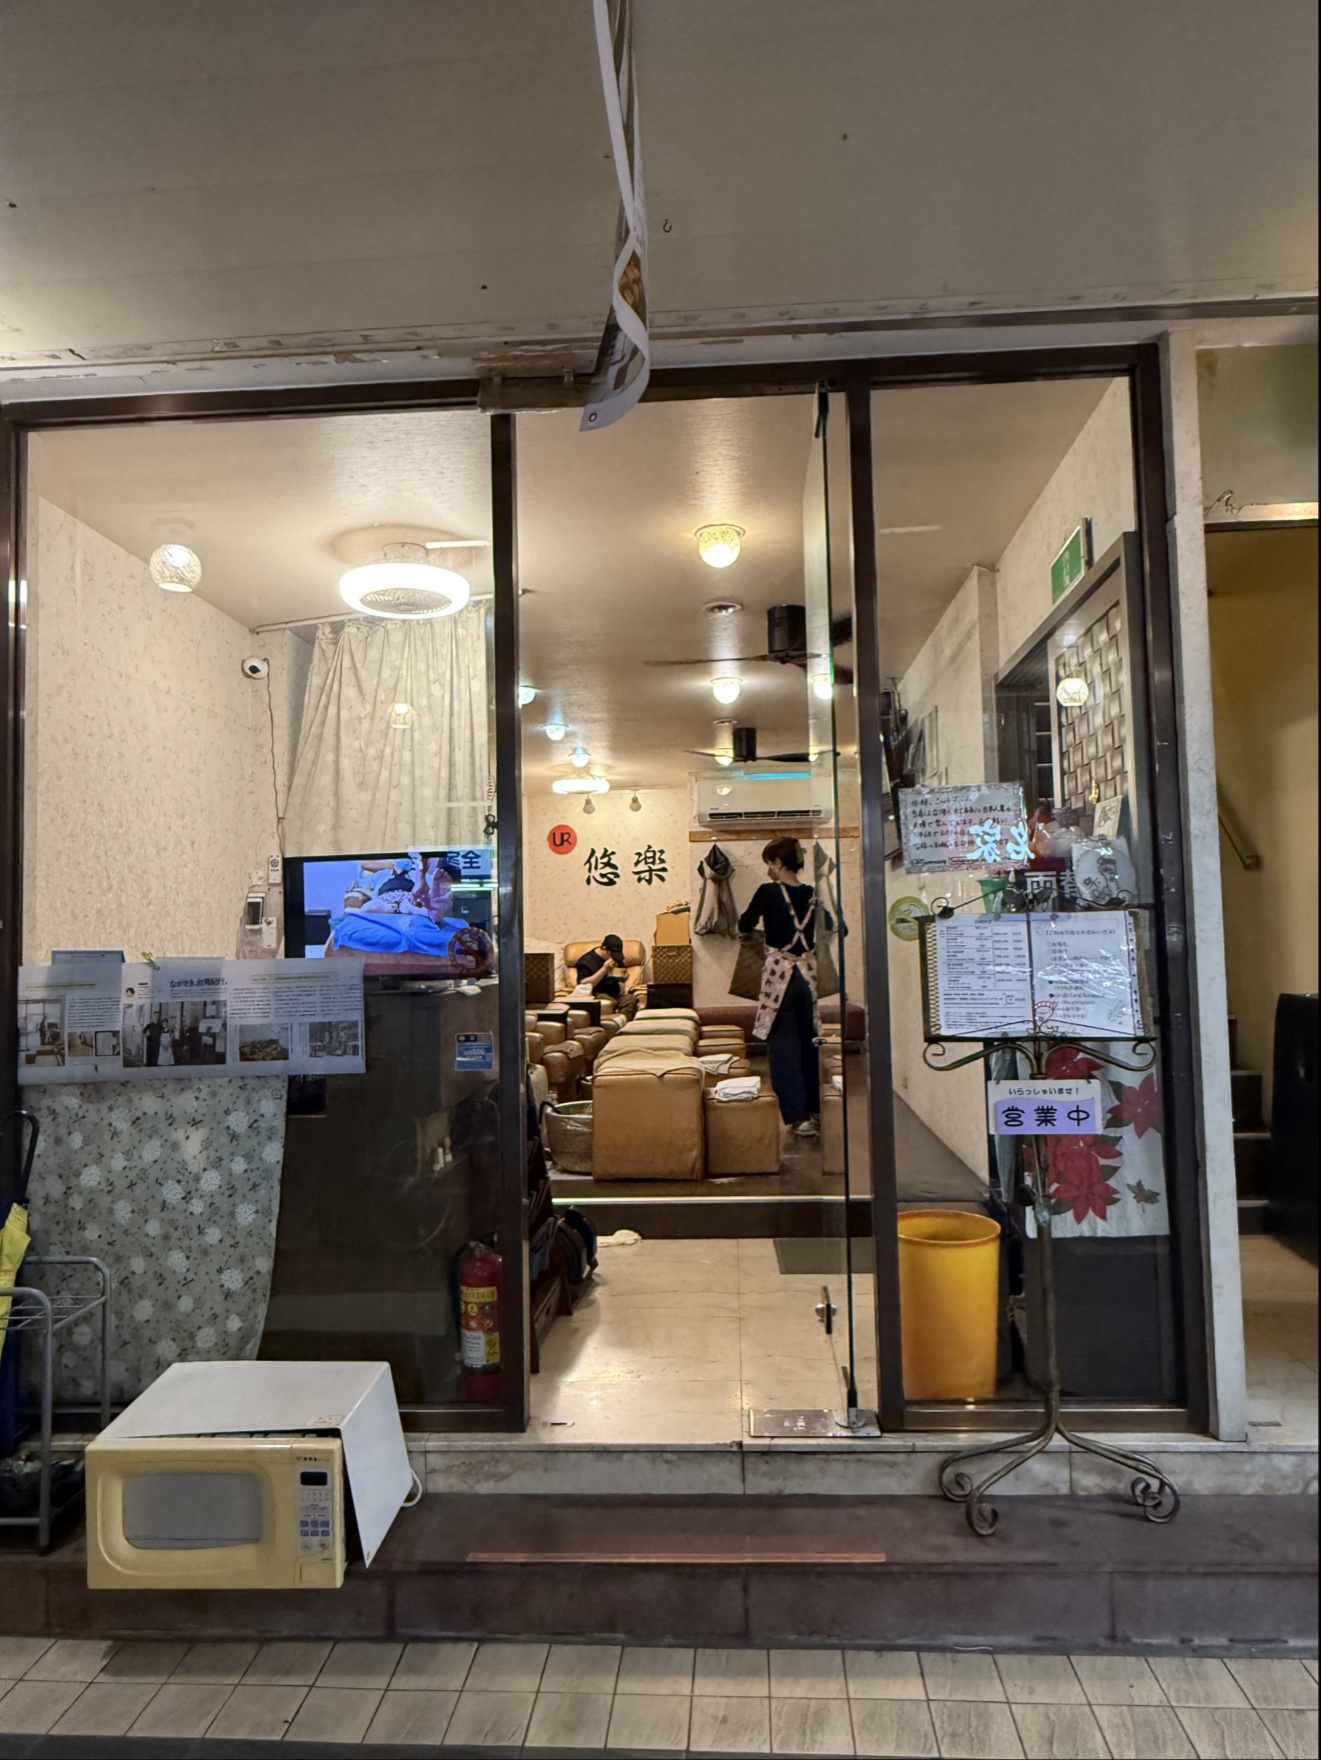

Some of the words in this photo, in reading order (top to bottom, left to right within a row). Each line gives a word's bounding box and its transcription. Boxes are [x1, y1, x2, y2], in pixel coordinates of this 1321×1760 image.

[552, 831, 572, 847] UR
[583, 844, 669, 887] 悠楽
[1008, 1087, 1079, 1096] いらっしゃいませ！
[1002, 1104, 1090, 1127] 営業中
